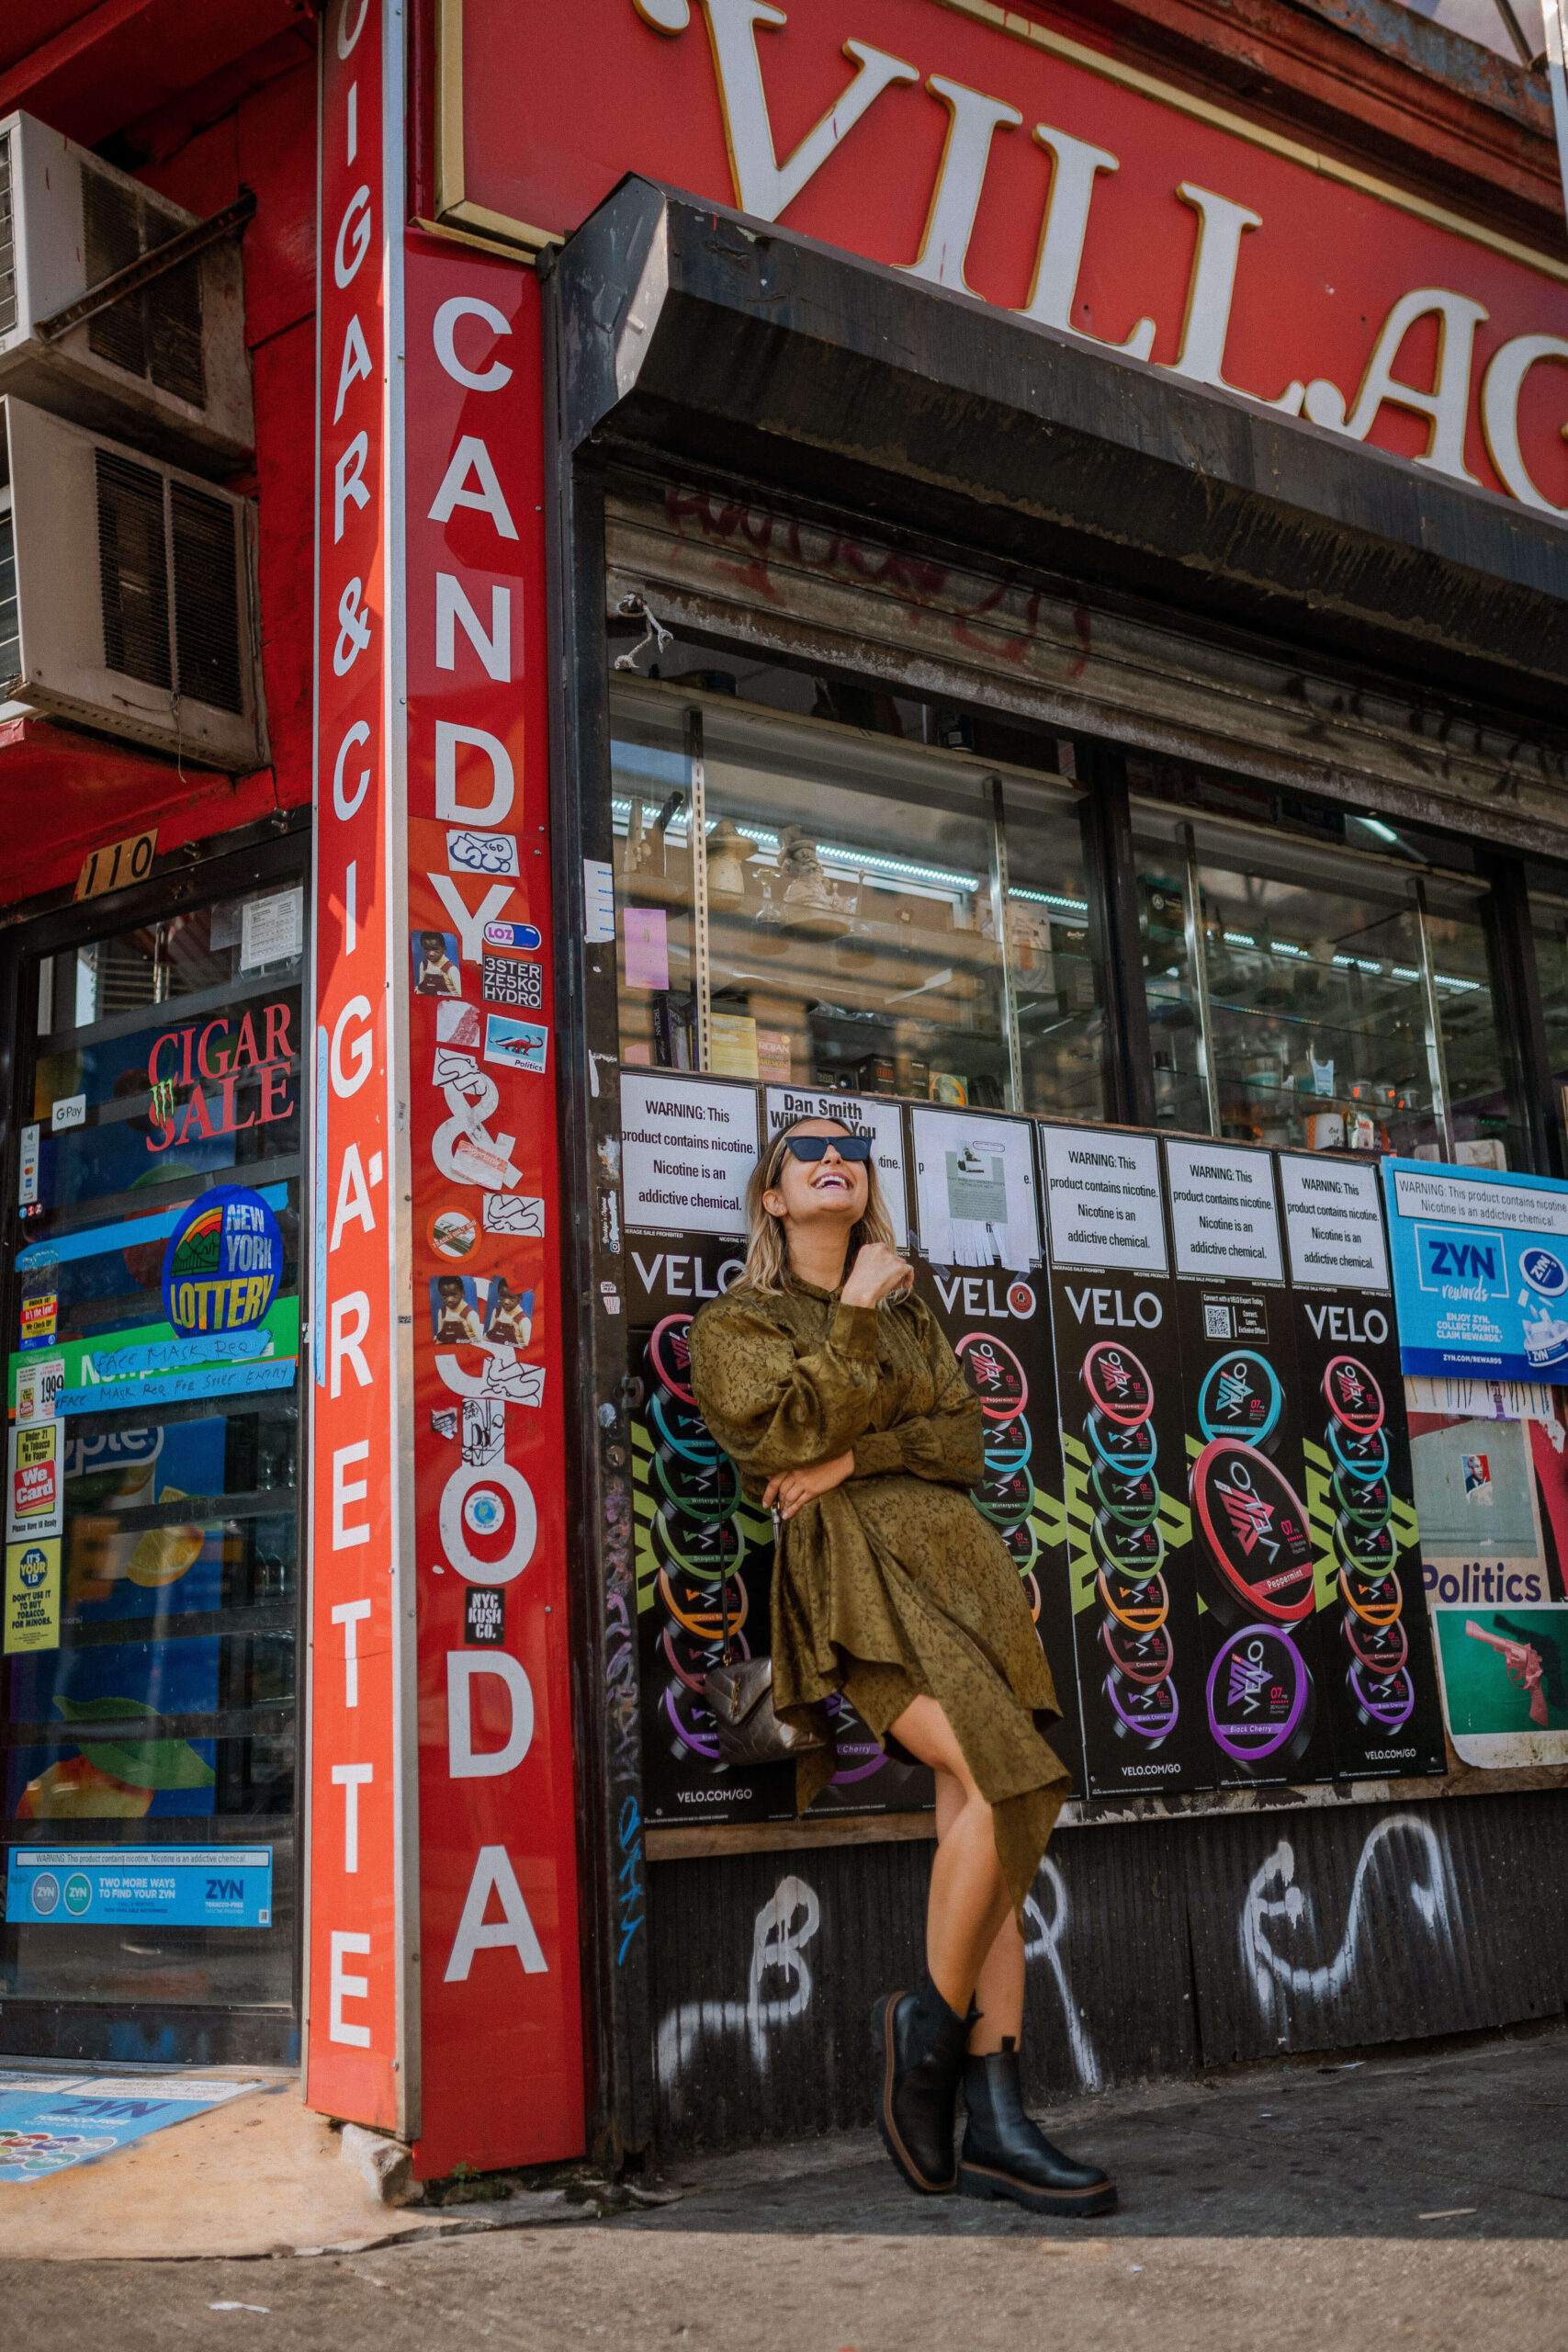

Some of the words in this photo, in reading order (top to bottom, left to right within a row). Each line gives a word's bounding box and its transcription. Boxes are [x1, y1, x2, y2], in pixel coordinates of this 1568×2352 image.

[333, 576, 371, 677] &
[426, 297, 520, 965] CANDY
[85, 835, 152, 896] 110
[488, 927, 513, 940] LOZ
[486, 957, 540, 979] 3STER
[484, 986, 540, 1007] HYDRO
[148, 1003, 295, 1089] CIGAR
[514, 1059, 543, 1072] Politics
[66, 1106, 82, 1118] Pay
[146, 1062, 294, 1153] SALE
[646, 1100, 705, 1121] WARNING:
[707, 1107, 729, 1123] This
[784, 1094, 813, 1114] Dan
[818, 1099, 863, 1120] Smith
[850, 1121, 876, 1140] You
[621, 1129, 661, 1145] product
[664, 1135, 708, 1149] contains
[711, 1138, 756, 1155] nicotine.
[653, 1159, 698, 1178] Nicotine
[702, 1164, 711, 1178] is
[713, 1168, 726, 1180] an
[1068, 1150, 1117, 1169] WARNING:
[1118, 1156, 1136, 1170] This
[1190, 1164, 1235, 1181] WARNING:
[1235, 1170, 1253, 1182] This
[1050, 1176, 1083, 1190] product
[1085, 1181, 1121, 1193] contains
[1122, 1183, 1158, 1197] nicotine.
[1302, 1178, 1343, 1193] WARNING:
[1343, 1183, 1359, 1195] This
[639, 1189, 688, 1205] addictive
[691, 1193, 742, 1211] chemical.
[1173, 1190, 1203, 1203] product
[1205, 1193, 1239, 1206] contains
[1240, 1195, 1273, 1210] nicotine.
[1399, 1180, 1447, 1196] WARNING:
[1449, 1185, 1466, 1199] This
[1468, 1189, 1499, 1204] product
[1501, 1193, 1535, 1208] contains
[1536, 1197, 1568, 1213] nicotine.
[226, 1204, 265, 1235] NEW
[1077, 1204, 1114, 1219] Nicotine
[1116, 1207, 1124, 1220] is
[1125, 1210, 1135, 1221] an
[1287, 1203, 1315, 1215] product
[1317, 1206, 1348, 1218] contains
[1349, 1208, 1379, 1222] nicotine.
[1421, 1199, 1456, 1215] Nicotine
[1458, 1204, 1466, 1216] is
[1468, 1207, 1478, 1217] an
[1480, 1207, 1517, 1222] addictive
[1518, 1211, 1556, 1227] chemical.
[1199, 1216, 1233, 1231] Nicotine
[1235, 1219, 1242, 1232] is
[1243, 1223, 1253, 1232] an
[1068, 1230, 1107, 1244] addictive
[1109, 1233, 1150, 1249] chemical.
[1311, 1227, 1343, 1242] Nicotine
[1344, 1230, 1351, 1243] is
[1352, 1234, 1361, 1244] an
[226, 1235, 273, 1272] YORK
[1190, 1241, 1226, 1255] addictive
[1228, 1244, 1267, 1259] chemical.
[1304, 1251, 1337, 1265] addictive
[1339, 1255, 1374, 1269] chemical.
[1429, 1240, 1496, 1280] ZYN
[1530, 1254, 1551, 1281] ZYN
[933, 1274, 1037, 1320] VELO
[1441, 1274, 1489, 1302] rewards
[170, 1273, 275, 1331] LOTTERY
[1064, 1286, 1163, 1329] VELO
[1304, 1304, 1388, 1345] VELO
[1437, 1321, 1471, 1331] COLLECT
[1472, 1323, 1502, 1333] POINTS.
[1446, 1312, 1471, 1321] ENJOY
[1472, 1314, 1490, 1324] ZYN.
[1436, 1329, 1461, 1339] CLAIM
[97, 1352, 135, 1373] FACE
[148, 1345, 202, 1364] MASK
[1443, 1353, 1502, 1364] ZYN.COM/REWARDS
[1532, 1349, 1549, 1362] ZYN
[1108, 1351, 1130, 1398] VELO
[100, 1386, 133, 1402] MASK
[329, 720, 374, 2049] CIGARETTE
[1227, 1363, 1248, 1419] VELO
[1250, 1399, 1261, 1409] 07
[22, 1467, 48, 1487] We
[17, 1478, 53, 1504] Card
[1230, 1461, 1280, 1565] VELO
[27, 1553, 40, 1564] IT'S
[20, 1562, 46, 1576] YOUR
[1267, 1568, 1303, 1589] Peppermint
[1422, 1562, 1541, 1603] Politics
[13, 1593, 31, 1602] DON'T
[32, 1590, 43, 1599] USE
[45, 1589, 51, 1598] IT
[20, 1601, 28, 1610] TO
[29, 1600, 41, 1609] BUY
[472, 1593, 499, 1609] NYC
[12, 1620, 23, 1629] FOR
[26, 1617, 51, 1628] MINORS.
[17, 1609, 45, 1619] TOBACCO
[468, 1608, 502, 1623] KUSH
[475, 1623, 496, 1639] CO.
[1243, 1640, 1264, 1717] VELO
[1270, 1687, 1283, 1699] 07
[1249, 1724, 1272, 1734] Cherry
[842, 1744, 871, 1754] Cherry
[1365, 1748, 1416, 1760] VELO.COM/GO
[1122, 1763, 1181, 1777] VELO.COM/GO
[677, 1788, 752, 1804] VELO.COM/GO
[67, 1854, 78, 1862] This
[79, 1854, 99, 1864] product
[101, 1854, 125, 1863] contains
[151, 1854, 175, 1863] Nicotine
[190, 1854, 217, 1863] addictive
[218, 1854, 246, 1863] chemical.
[37, 1886, 54, 1897] ZYN
[99, 1877, 121, 1888] TWO
[122, 1877, 148, 1888] MORE
[150, 1878, 175, 1888] WAYS
[206, 1879, 244, 1899] ZYN
[69, 1887, 87, 1898] ZYN
[99, 1889, 110, 1898] TO
[111, 1889, 132, 1899] FIND
[133, 1889, 157, 1899] YOUR
[158, 1889, 175, 1899] ZYN
[49, 2099, 173, 2119] ZYN
